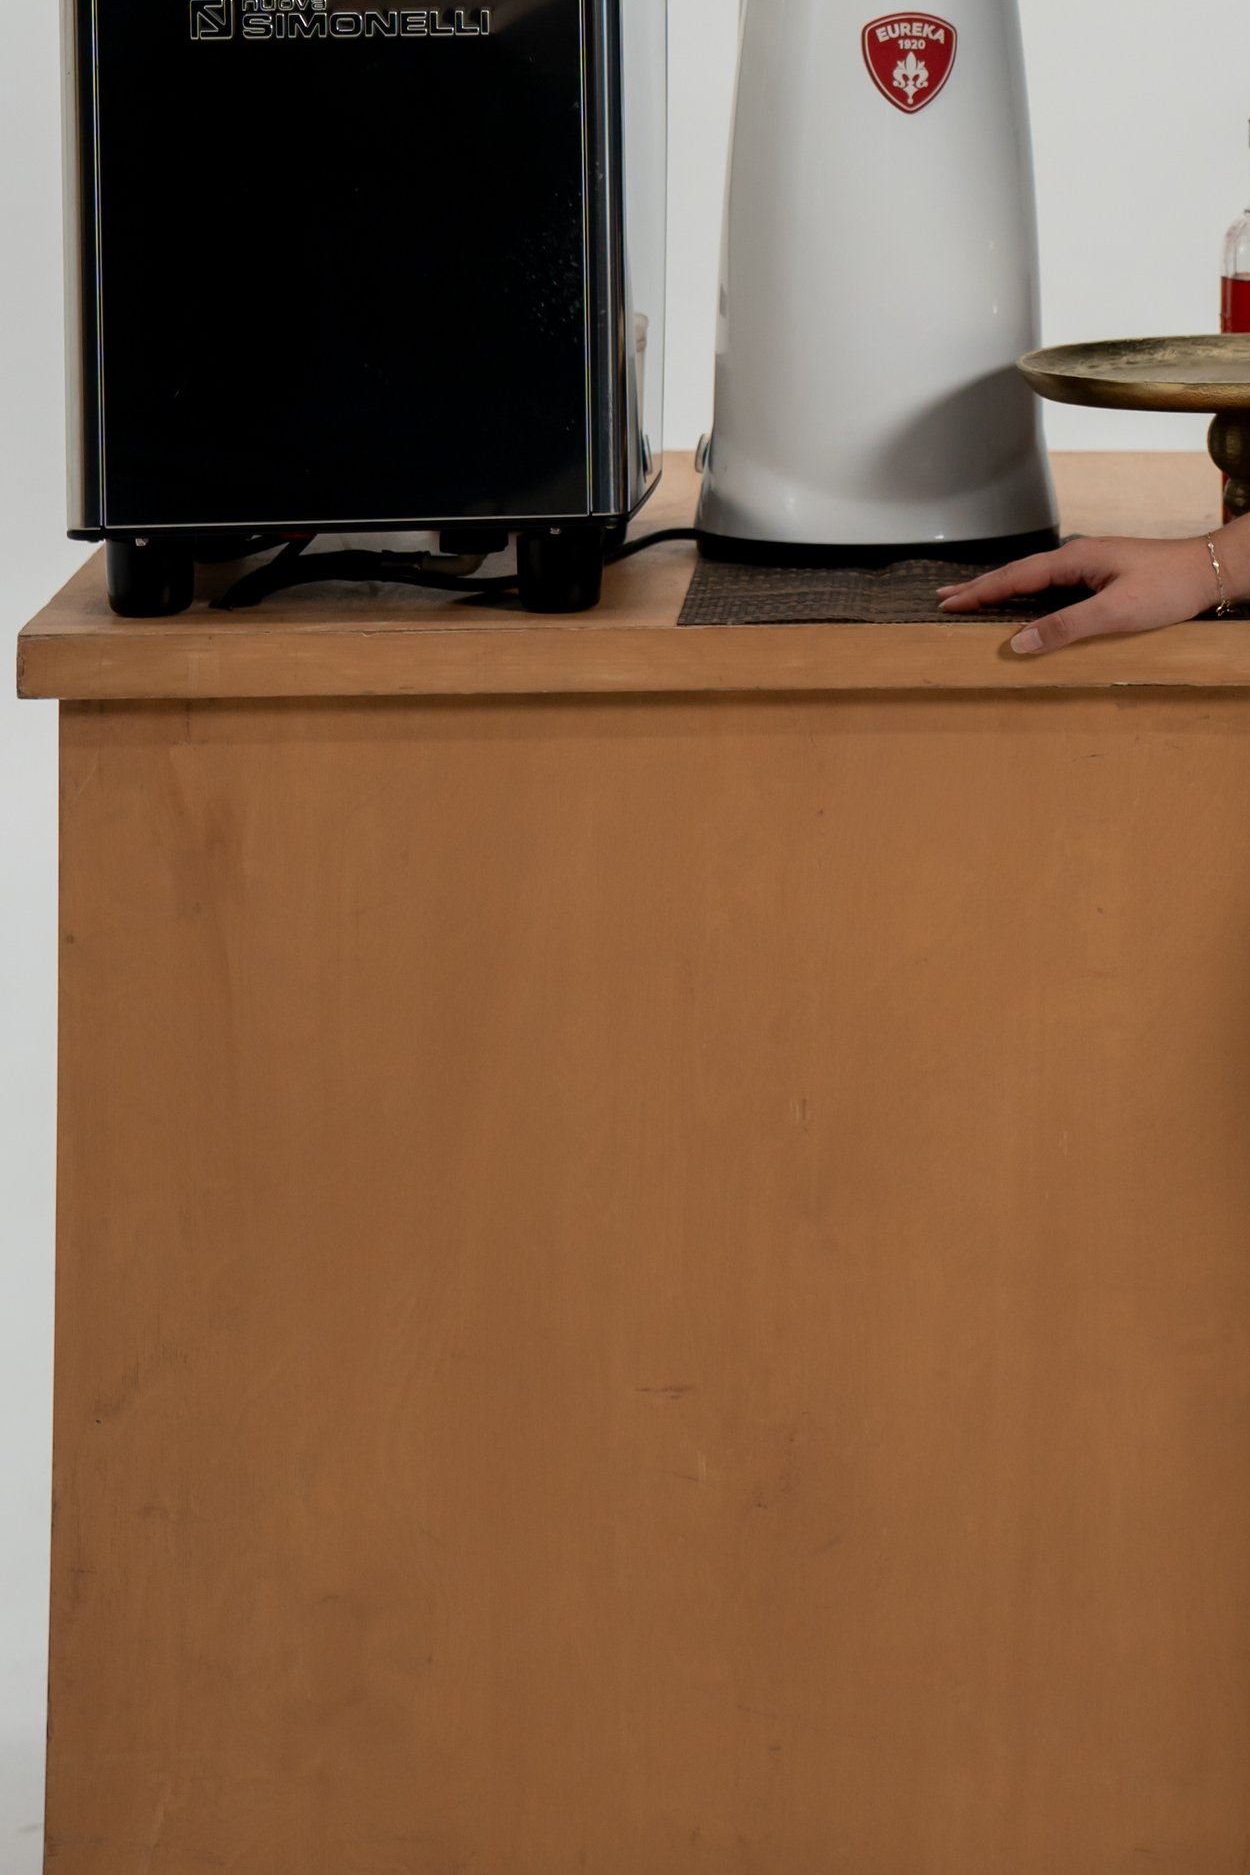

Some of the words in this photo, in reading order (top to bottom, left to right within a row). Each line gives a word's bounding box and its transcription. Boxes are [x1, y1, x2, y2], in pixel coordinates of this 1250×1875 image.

[242, 10, 490, 38] SIMONELLI
[875, 22, 945, 44] EUREKA
[898, 39, 926, 50] 1920
